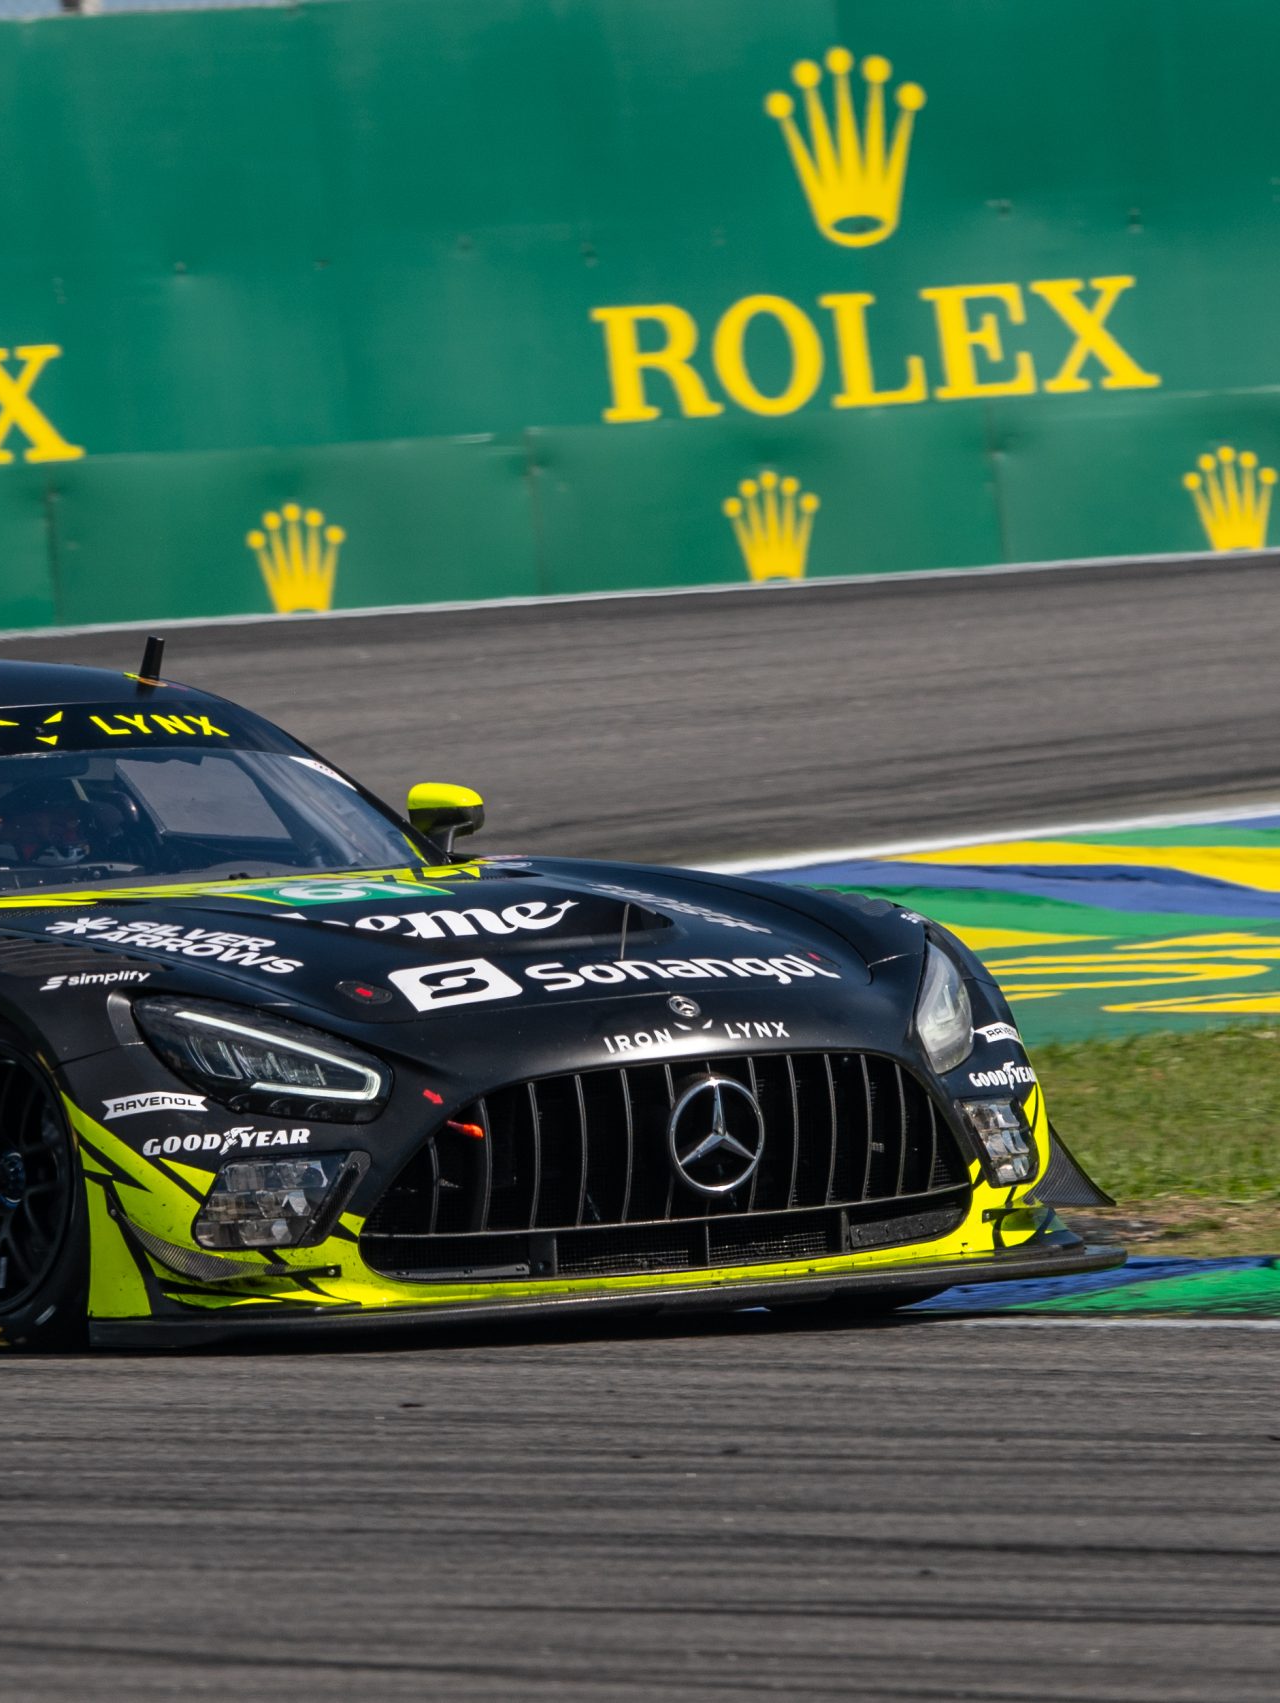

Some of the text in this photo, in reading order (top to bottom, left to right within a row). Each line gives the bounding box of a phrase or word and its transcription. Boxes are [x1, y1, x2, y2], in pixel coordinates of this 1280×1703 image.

[591, 275, 1161, 423] ROLEX
[90, 713, 230, 738] LYNX
[277, 882, 417, 901] 61
[89, 926, 305, 974] ARROWS
[119, 920, 277, 952] SILVER
[68, 970, 151, 987] simplify
[525, 952, 841, 993] Sonangol
[604, 1020, 791, 1054] IRON LYNX
[112, 1094, 206, 1114] RAVENOL
[143, 1126, 311, 1156] GOODYEAR
